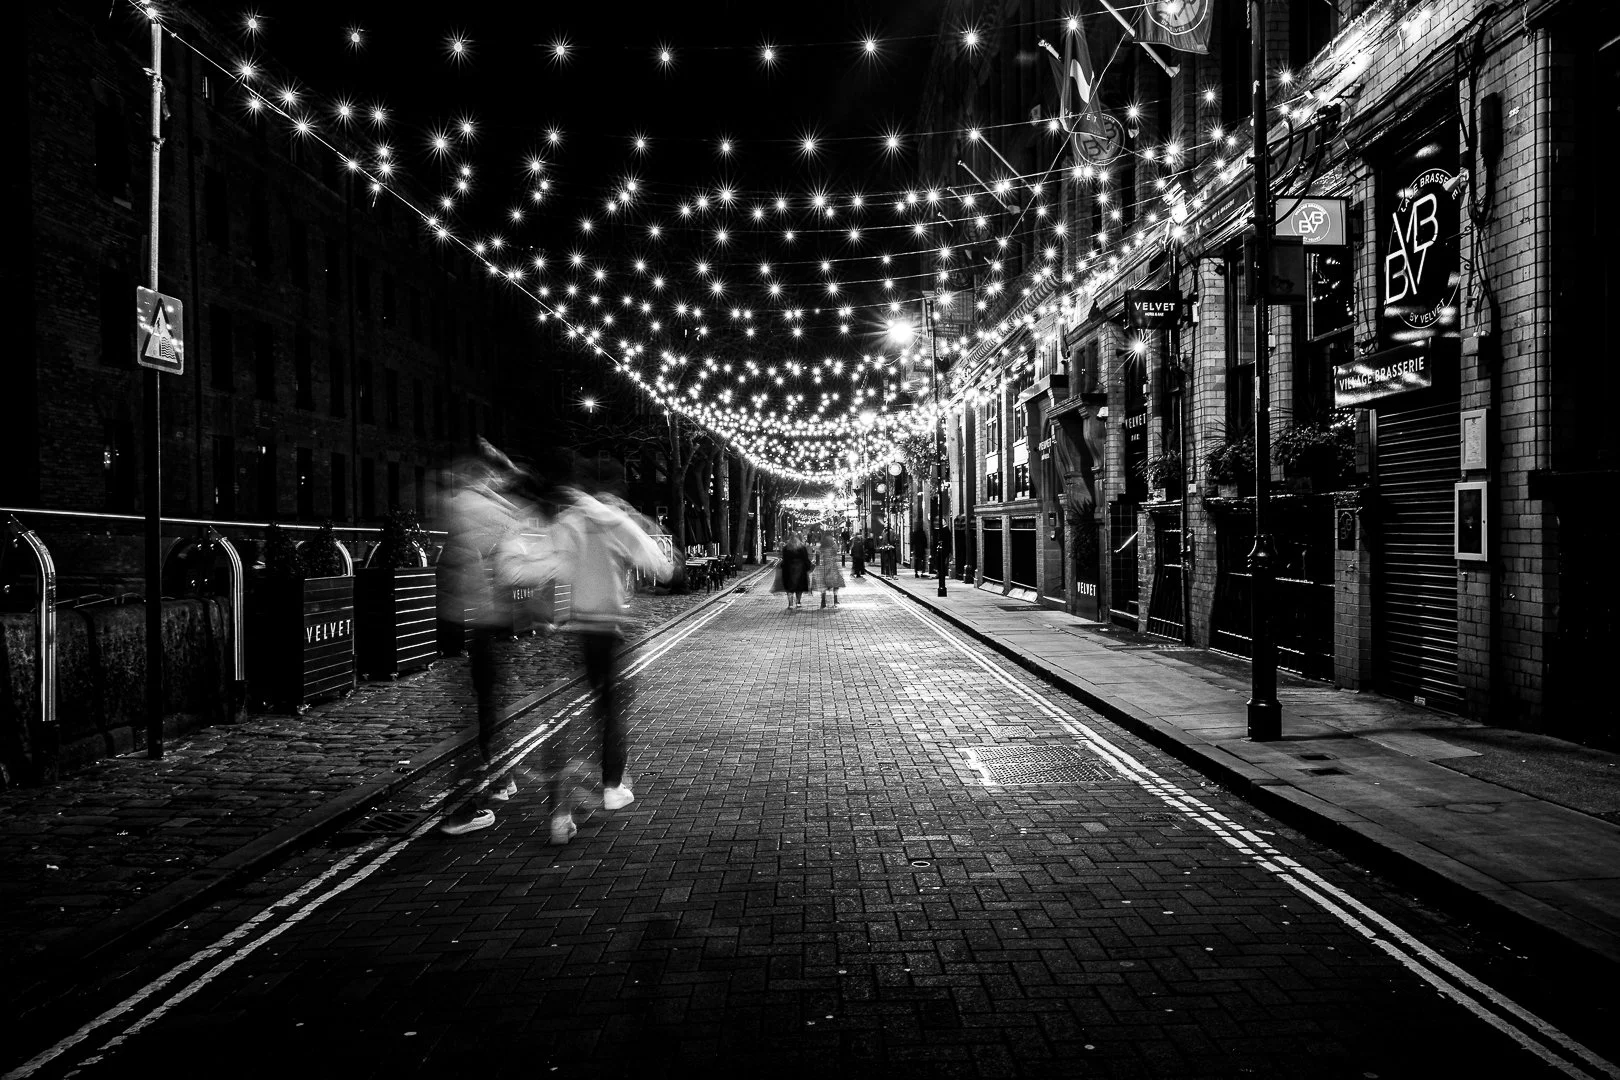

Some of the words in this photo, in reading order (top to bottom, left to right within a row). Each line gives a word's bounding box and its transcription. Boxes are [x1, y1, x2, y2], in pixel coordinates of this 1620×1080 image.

[1134, 301, 1176, 312] VELVET
[1420, 298, 1445, 324] VELVET
[1374, 356, 1425, 382] BRASSERIE
[1076, 581, 1097, 597] VELVET
[306, 619, 351, 643] VELVET
